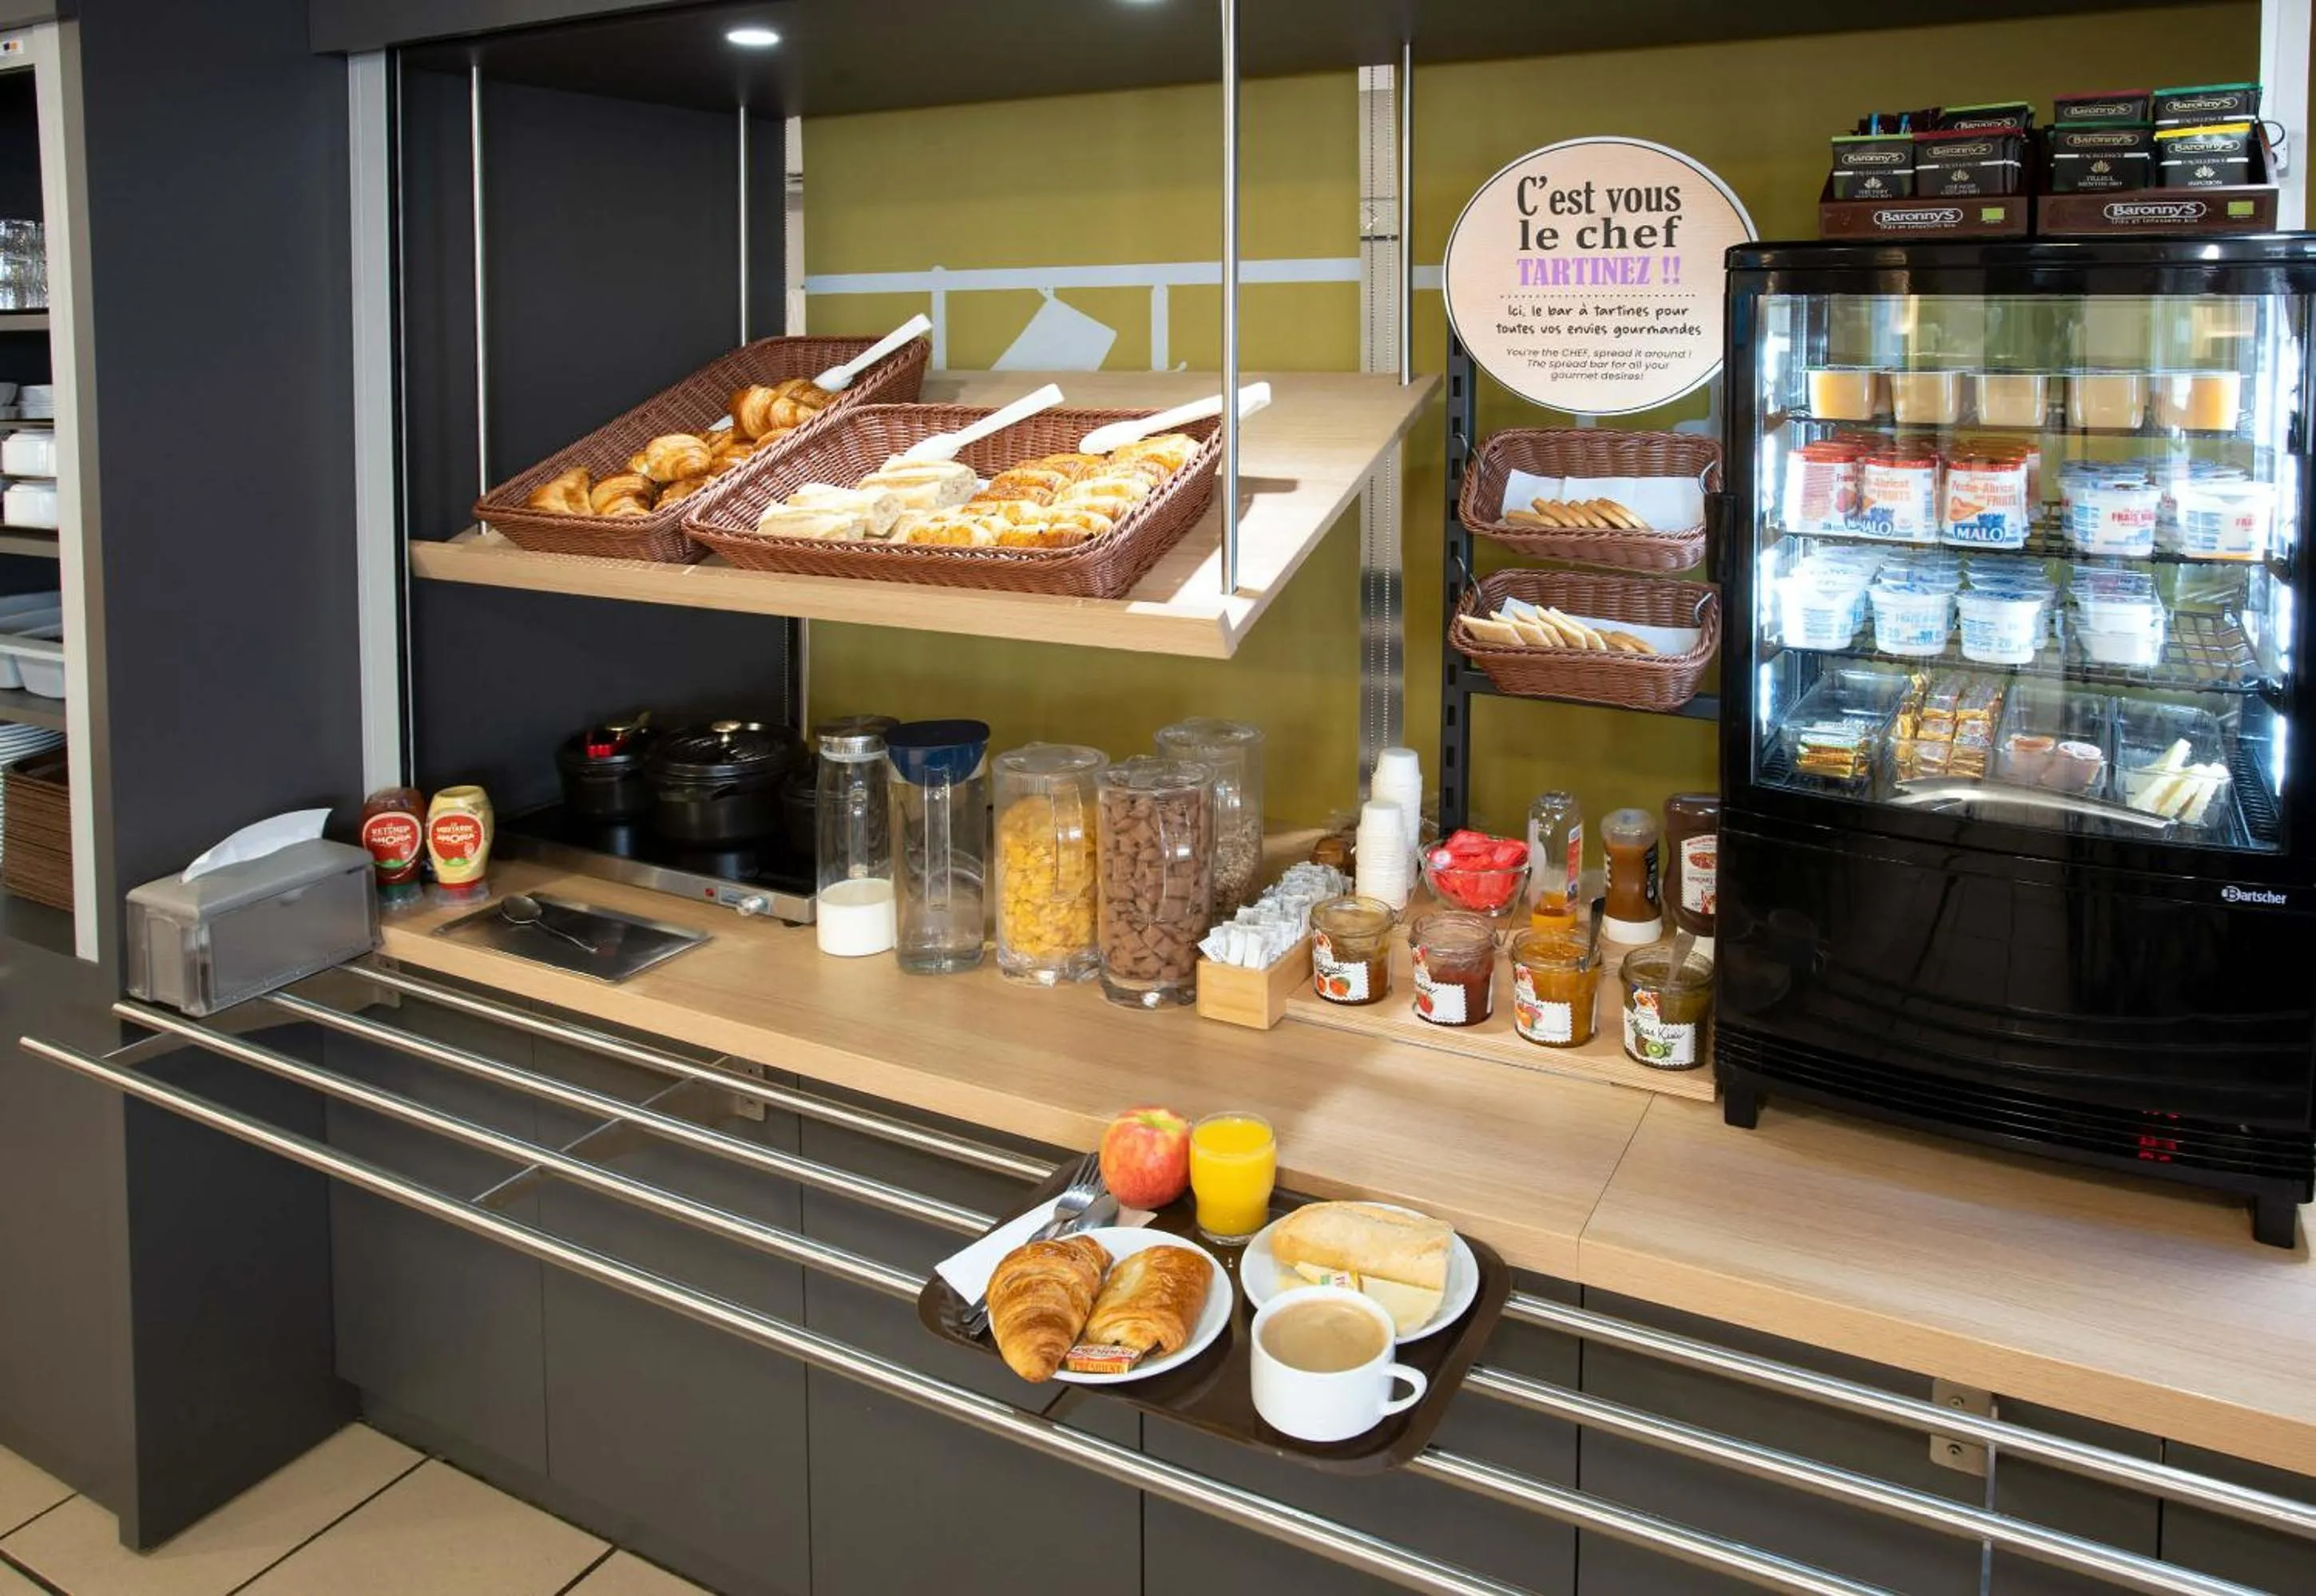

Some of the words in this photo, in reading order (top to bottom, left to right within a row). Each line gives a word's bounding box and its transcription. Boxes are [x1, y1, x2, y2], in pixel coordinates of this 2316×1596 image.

[1517, 175, 1596, 216] C'est
[1605, 185, 1682, 214] vous
[1519, 219, 1560, 251] le
[1576, 215, 1683, 249] chef
[1517, 255, 1652, 287] TARTINEZ
[1662, 255, 1681, 285] !!
[1532, 304, 1542, 316] le
[1548, 305, 1572, 316] bar
[1579, 303, 1589, 315] à
[1594, 304, 1650, 317] tartines
[1656, 306, 1691, 319] pour
[1496, 322, 1535, 335] toutes
[1540, 324, 1562, 335] vos
[1567, 323, 1608, 335] envies
[1613, 323, 1703, 339] gourmandes
[1541, 347, 1559, 357] the
[1593, 349, 1633, 360] spread
[1635, 349, 1642, 358] it
[1644, 349, 1687, 358] around
[1527, 358, 1546, 368] The
[1548, 359, 1588, 370] spread
[1589, 359, 1609, 369] bar
[1611, 360, 1627, 369] for
[1628, 360, 1642, 369] all
[1644, 362, 1671, 371] your
[1550, 372, 1598, 382] gourmet
[1600, 371, 1644, 381] desires!
[1957, 527, 2004, 541] MALO
[371, 826, 410, 834] KETCHUP
